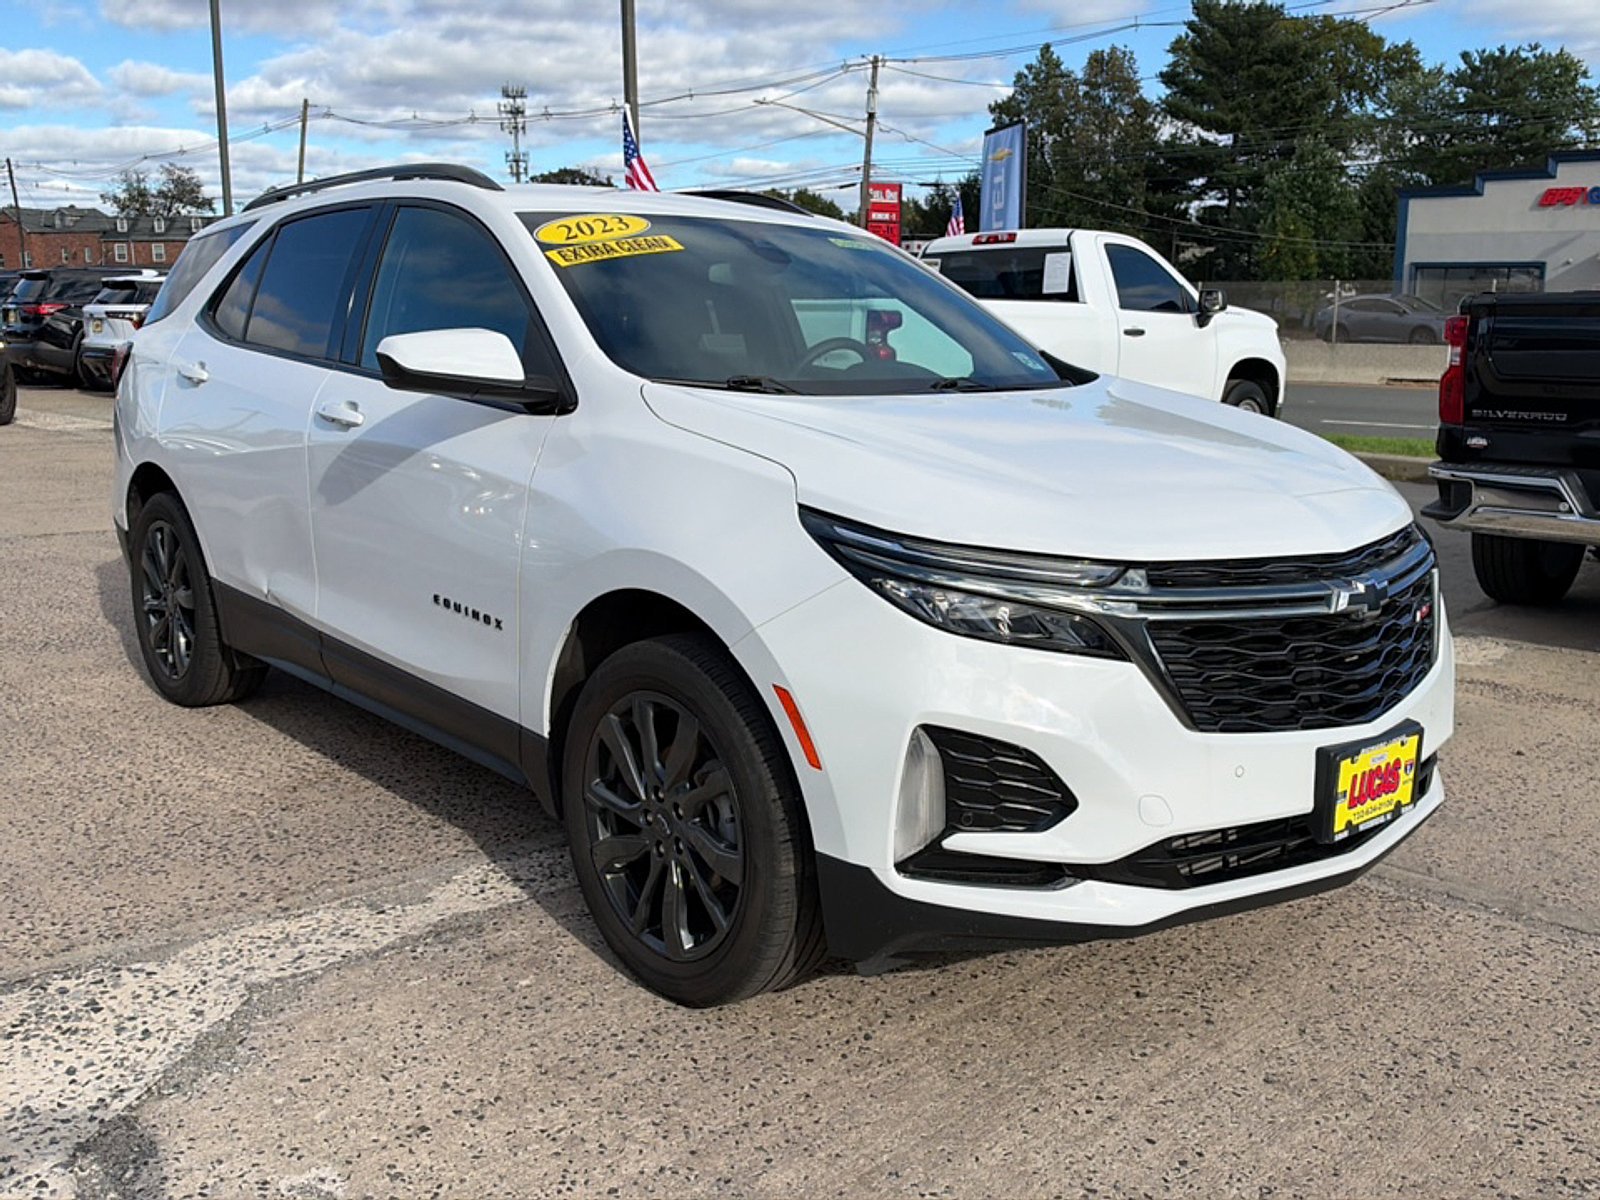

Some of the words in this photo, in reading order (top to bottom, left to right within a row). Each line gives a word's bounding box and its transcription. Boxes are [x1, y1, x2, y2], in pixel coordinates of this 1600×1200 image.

[557, 216, 630, 240] 2023
[558, 244, 617, 262] EXTRA
[616, 237, 670, 252] CLEAN
[1472, 409, 1567, 421] SILVERADO
[433, 593, 503, 631] EQUINOX
[1348, 757, 1402, 809] LUCAS
